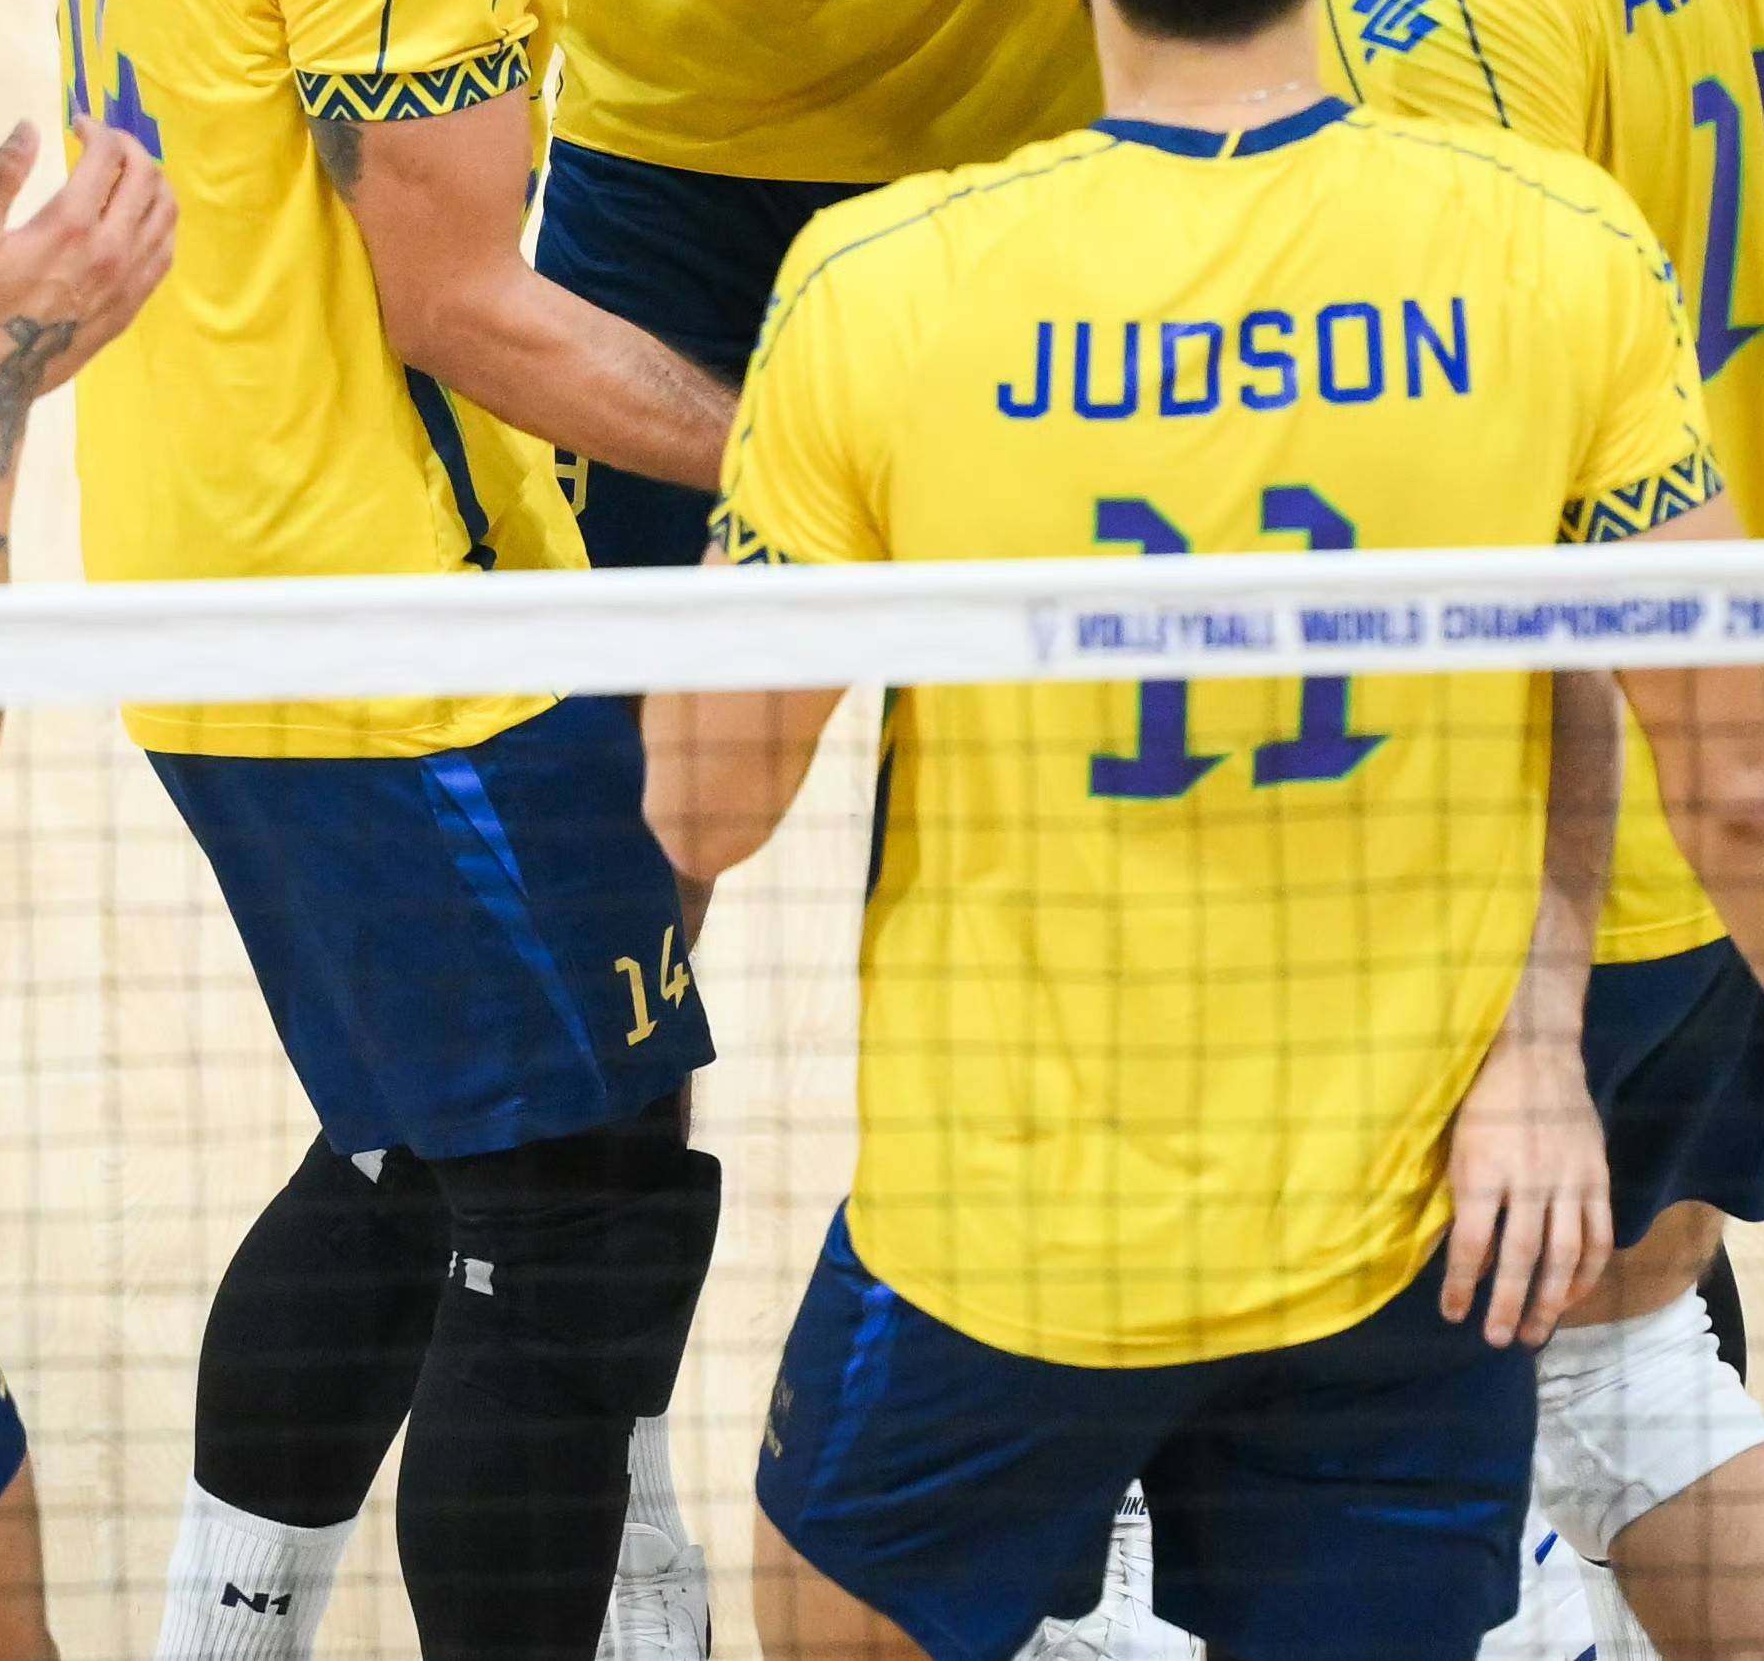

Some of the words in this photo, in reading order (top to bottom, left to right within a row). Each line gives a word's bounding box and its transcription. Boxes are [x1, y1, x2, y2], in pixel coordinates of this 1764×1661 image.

[996, 295, 1473, 421] JUDSON
[1087, 483, 1389, 799] 11
[614, 924, 691, 1047] 14
